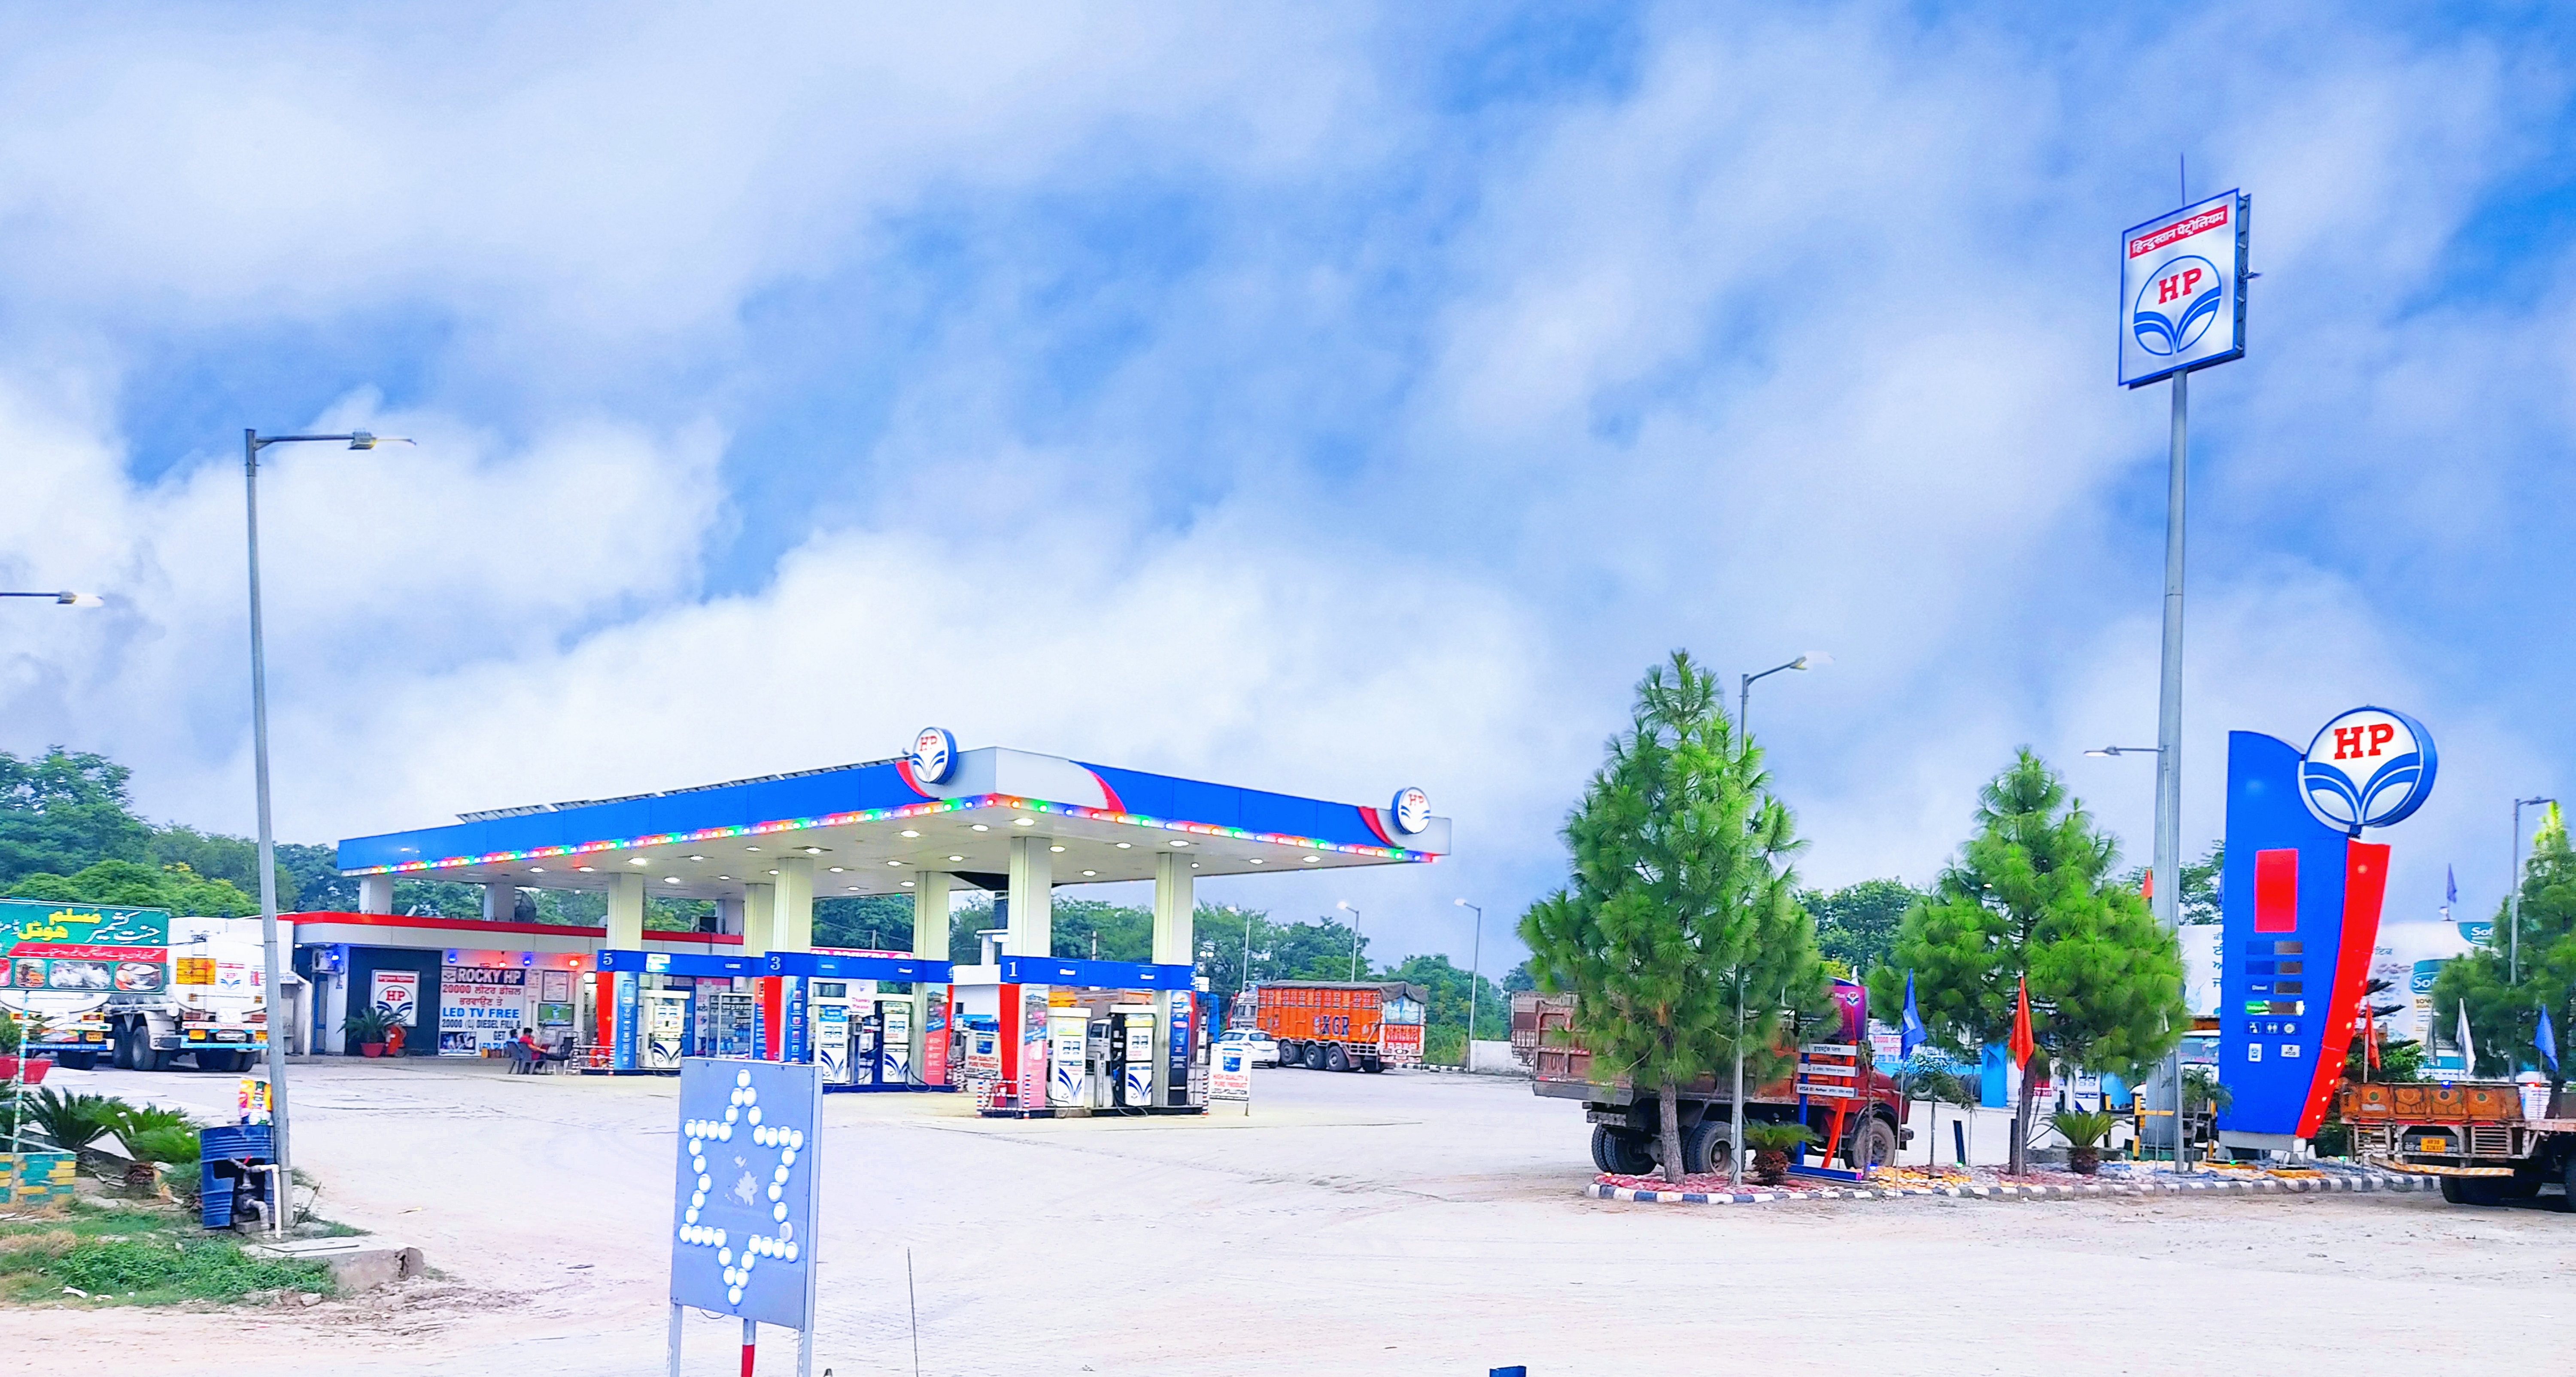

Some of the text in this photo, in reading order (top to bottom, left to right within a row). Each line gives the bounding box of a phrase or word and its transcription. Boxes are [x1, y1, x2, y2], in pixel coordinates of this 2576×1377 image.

[2132, 211, 2225, 253] हिन्दुस्तान पेट्रोलियम
[2158, 267, 2202, 305] HP
[920, 735, 938, 751] HP
[2333, 723, 2394, 760] HP
[1408, 793, 1425, 806] HP
[603, 953, 614, 965] 5
[770, 956, 781, 970] 3
[1009, 961, 1018, 977] 1
[457, 968, 502, 983] ROCKY
[503, 970, 521, 984] HP
[386, 990, 405, 1001] HP
[442, 984, 471, 994] 20000
[474, 984, 496, 994] ਲੀਟਰ
[443, 1007, 519, 1018] LED TV FREE
[441, 1018, 462, 1028] 20000
[476, 1019, 499, 1029] DIESEL
[493, 1030, 506, 1041] GET
